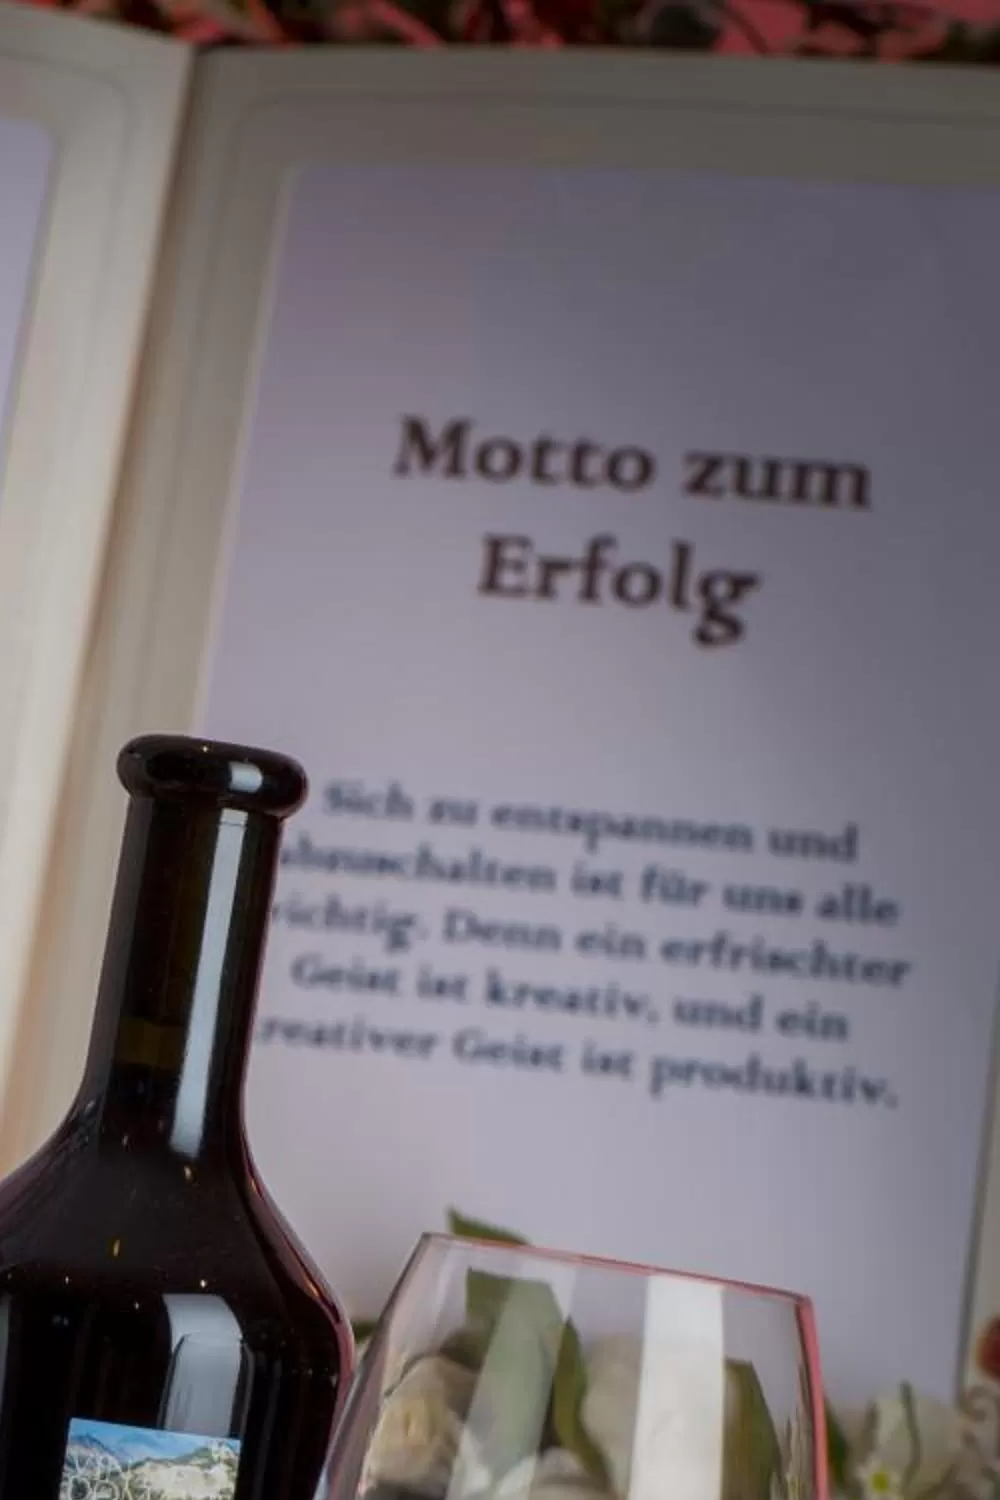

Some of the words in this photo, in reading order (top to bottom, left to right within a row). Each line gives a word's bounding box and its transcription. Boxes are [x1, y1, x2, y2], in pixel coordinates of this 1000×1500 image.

[393, 412, 656, 494] Motto
[684, 448, 872, 511] zum
[477, 530, 760, 648] Erfolg
[323, 780, 415, 824] Sich
[426, 796, 482, 830] zu
[488, 796, 754, 856] entspannen
[765, 822, 861, 864] und
[572, 858, 623, 900] ist
[640, 862, 708, 906] für
[722, 886, 804, 918] uns
[813, 882, 900, 926] alle
[442, 906, 563, 954] Denn
[573, 920, 648, 962] ein
[659, 928, 912, 990] erfrischter
[289, 951, 400, 1000] Geist
[415, 962, 469, 1003] ist
[672, 991, 764, 1035] und
[774, 1000, 850, 1044] ein
[260, 1012, 439, 1062] reativer
[451, 1026, 566, 1076] Geist
[580, 1039, 634, 1082] ist
[648, 1050, 900, 1112] produktiv.
